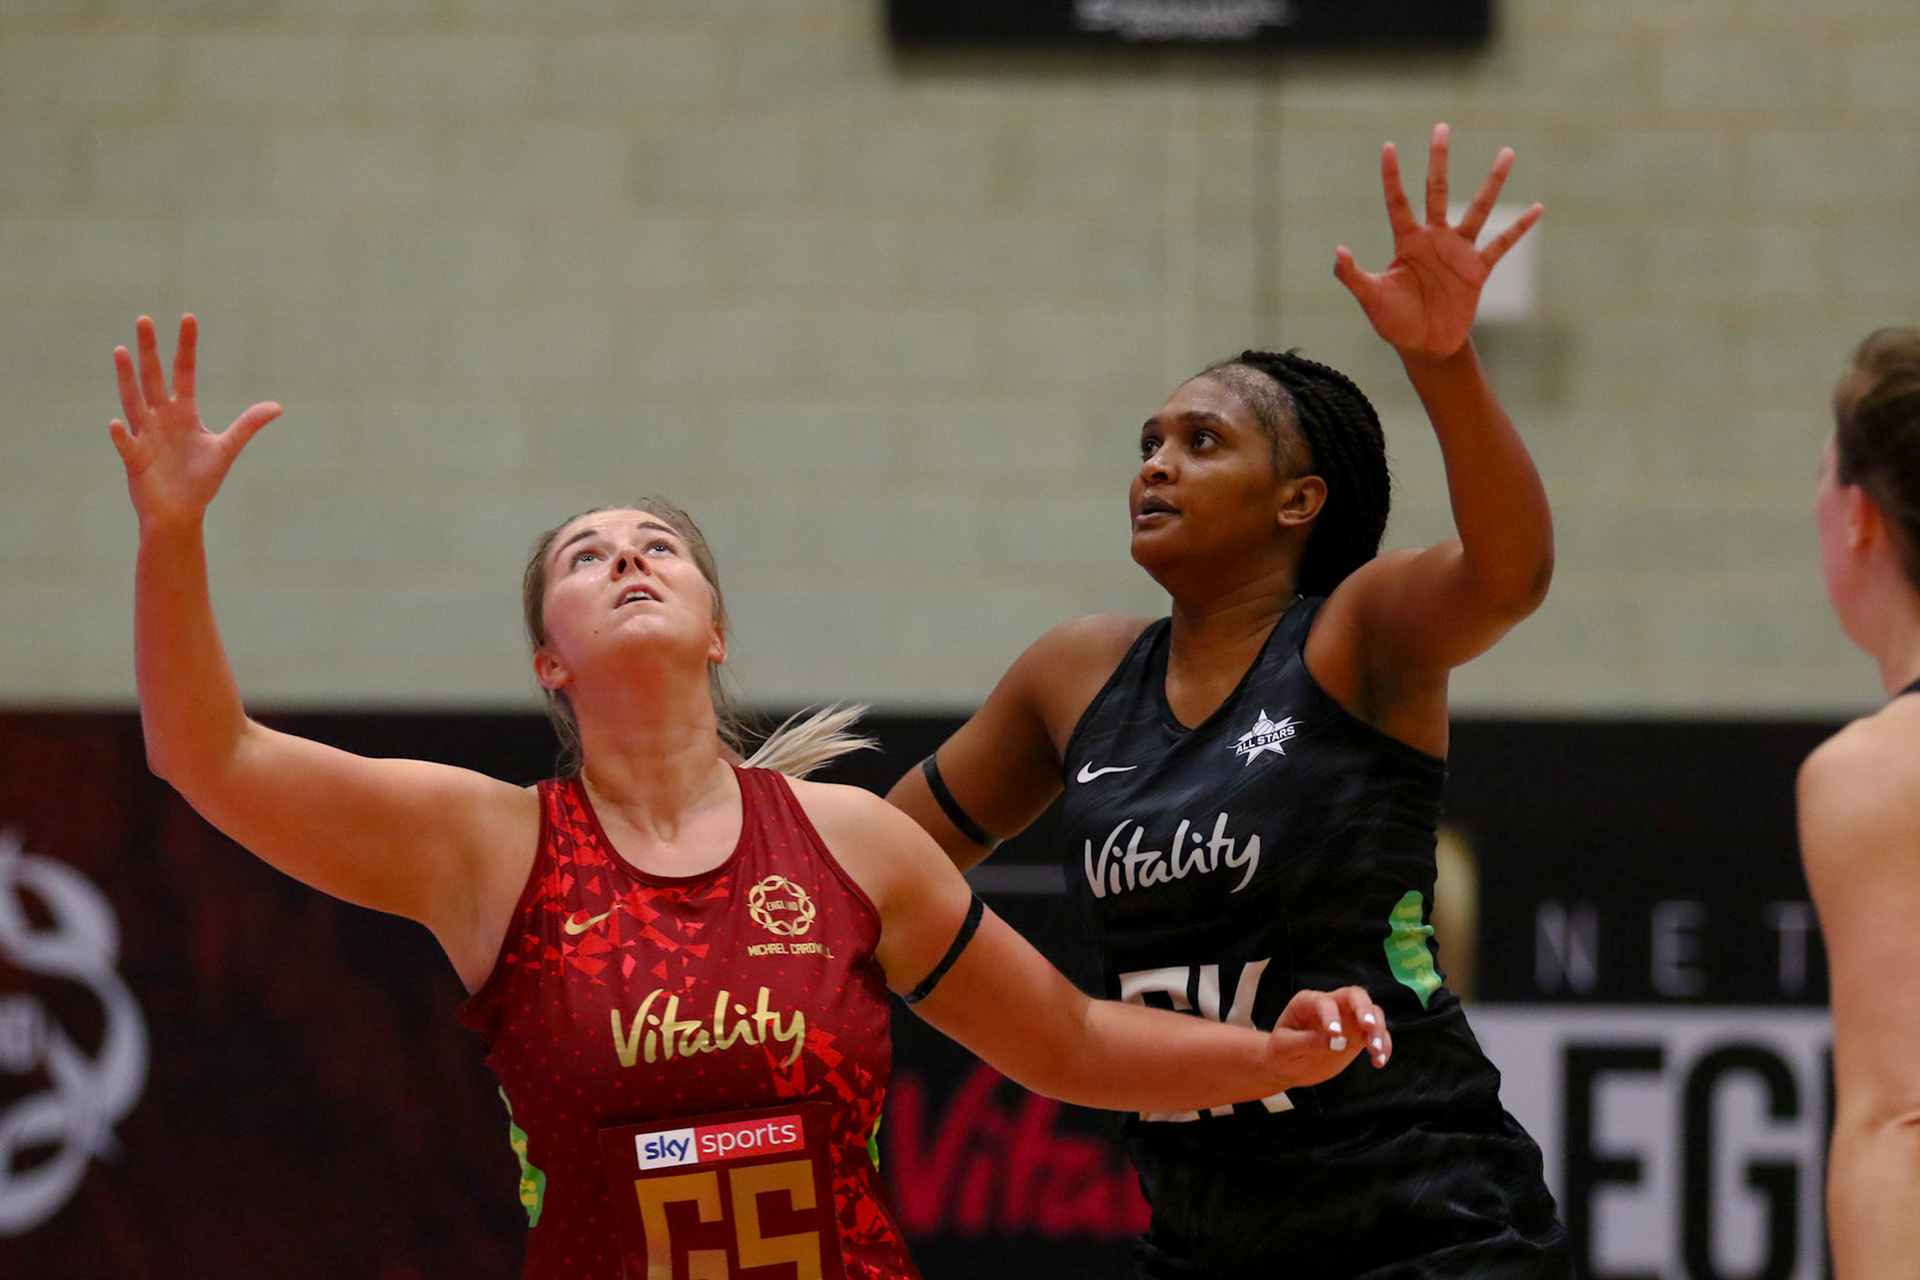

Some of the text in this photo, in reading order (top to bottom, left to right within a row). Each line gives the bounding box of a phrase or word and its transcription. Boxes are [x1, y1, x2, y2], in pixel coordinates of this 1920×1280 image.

[1236, 725, 1296, 755] ALL STARS
[1085, 812, 1261, 899] Vitality
[766, 900, 799, 912] ENGLND
[747, 943, 789, 957] MICHAEL
[611, 987, 806, 1068] Vitality
[644, 1123, 797, 1162] sky sports
[1562, 1040, 1835, 1280] EG
[634, 1159, 824, 1280] GS
